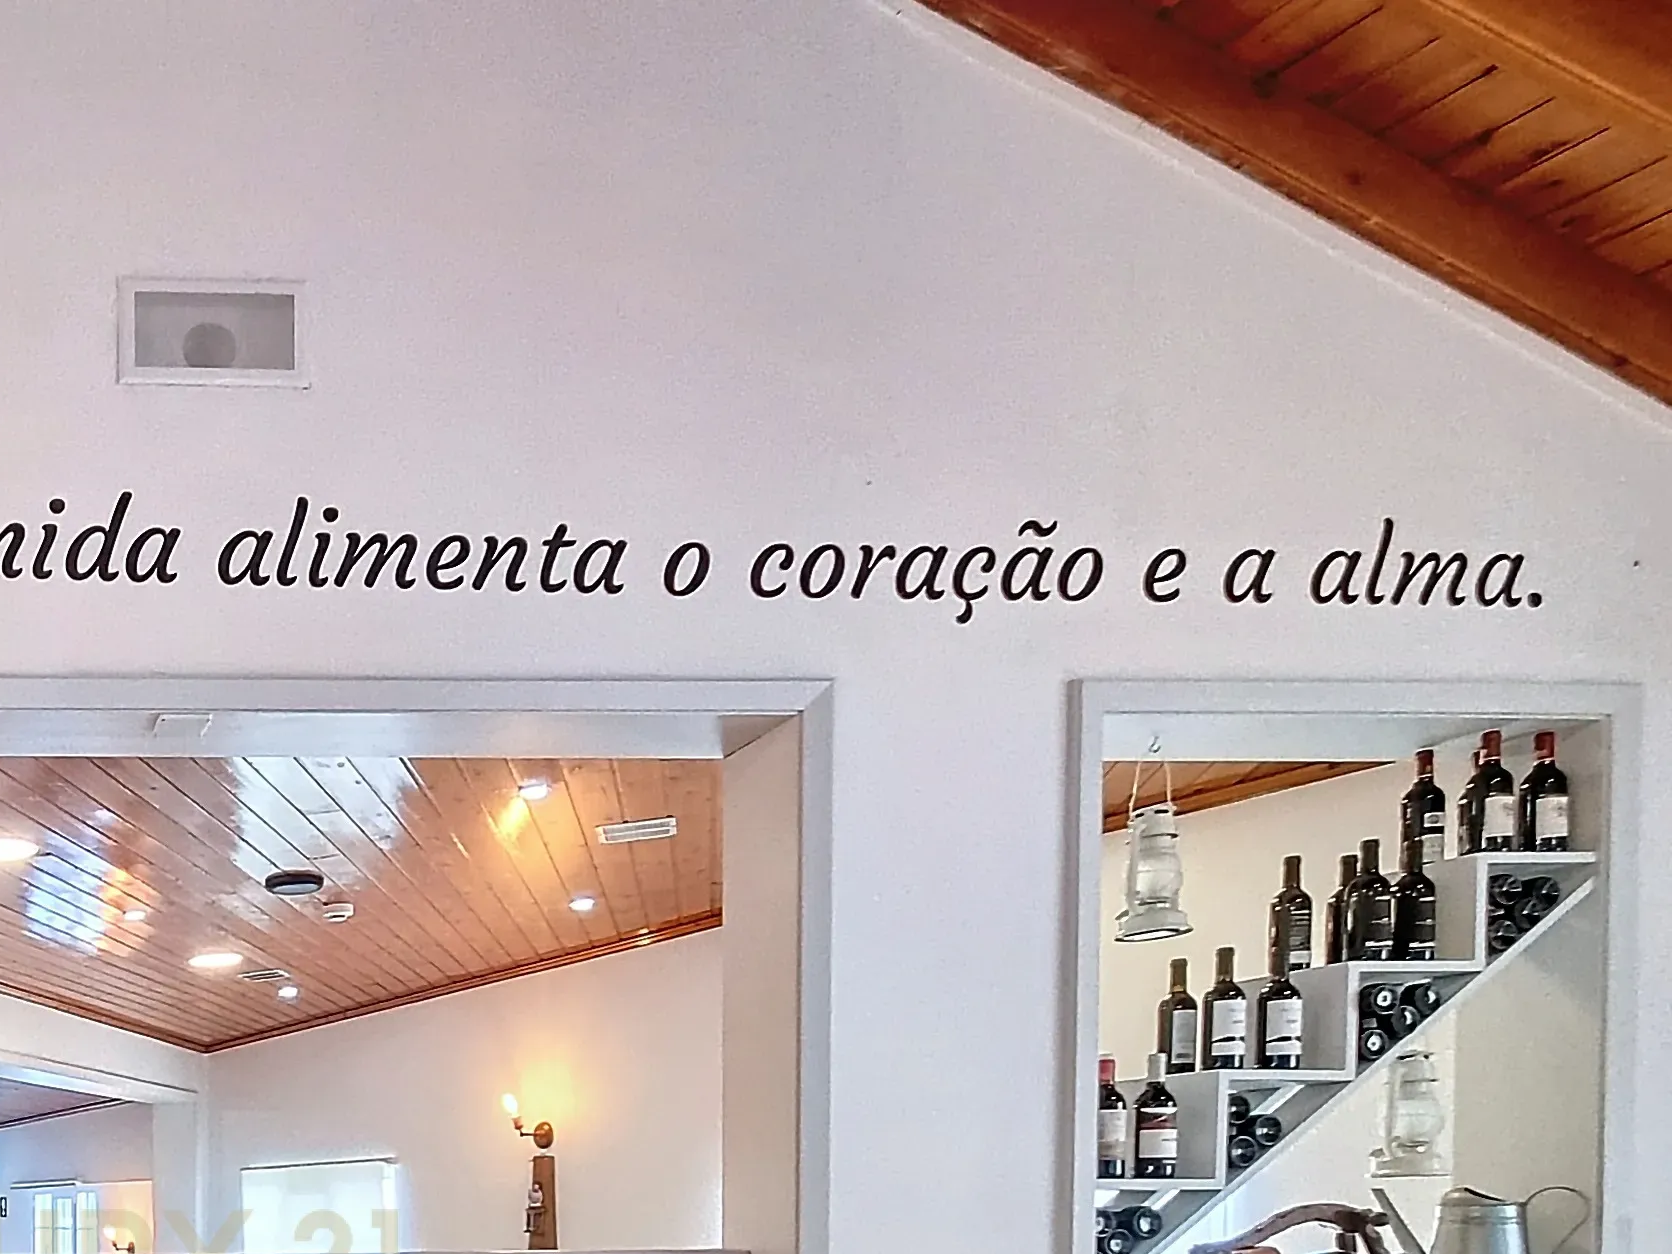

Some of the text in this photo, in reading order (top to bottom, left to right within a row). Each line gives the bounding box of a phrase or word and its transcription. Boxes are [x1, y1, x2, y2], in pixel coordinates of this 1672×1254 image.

[217, 496, 628, 595] alimenta
[663, 542, 711, 597] o
[750, 519, 1104, 625] coração
[1144, 548, 1187, 603] e
[1223, 548, 1276, 604] a
[1311, 517, 1543, 608] alma.
